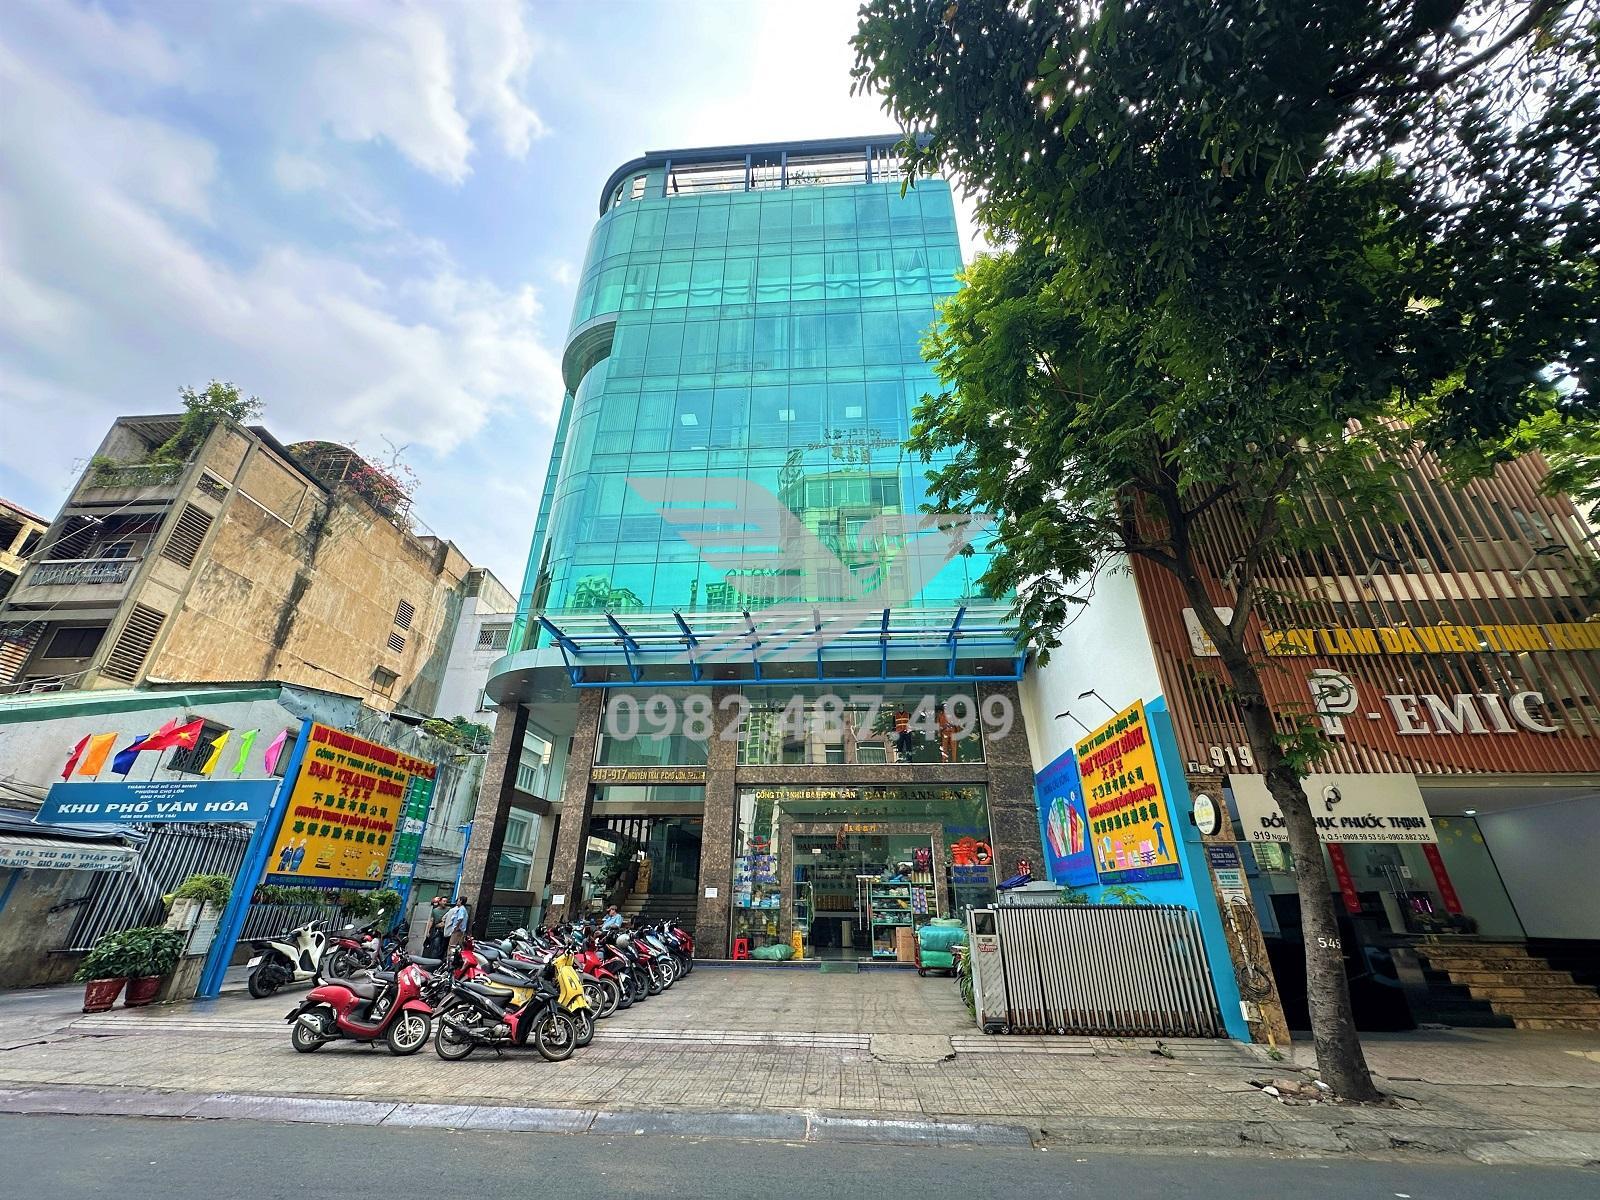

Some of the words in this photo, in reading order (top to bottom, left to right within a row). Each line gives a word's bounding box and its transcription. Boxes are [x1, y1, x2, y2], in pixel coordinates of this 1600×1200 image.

[1480, 624, 1549, 651] TINH
[1209, 746, 1255, 768] 919
[58, 803, 100, 813] KHU
[105, 800, 153, 813] PHỐ
[156, 801, 199, 812] VĂN
[204, 800, 249, 812] HÓA
[1261, 812, 1287, 827] ĐỒN
[1315, 816, 1338, 830] HỤC
[1340, 813, 1386, 828] PHƯỚC
[1387, 816, 1427, 830] THỊNH
[1253, 831, 1270, 840] 919
[1271, 833, 1289, 841] Nguy
